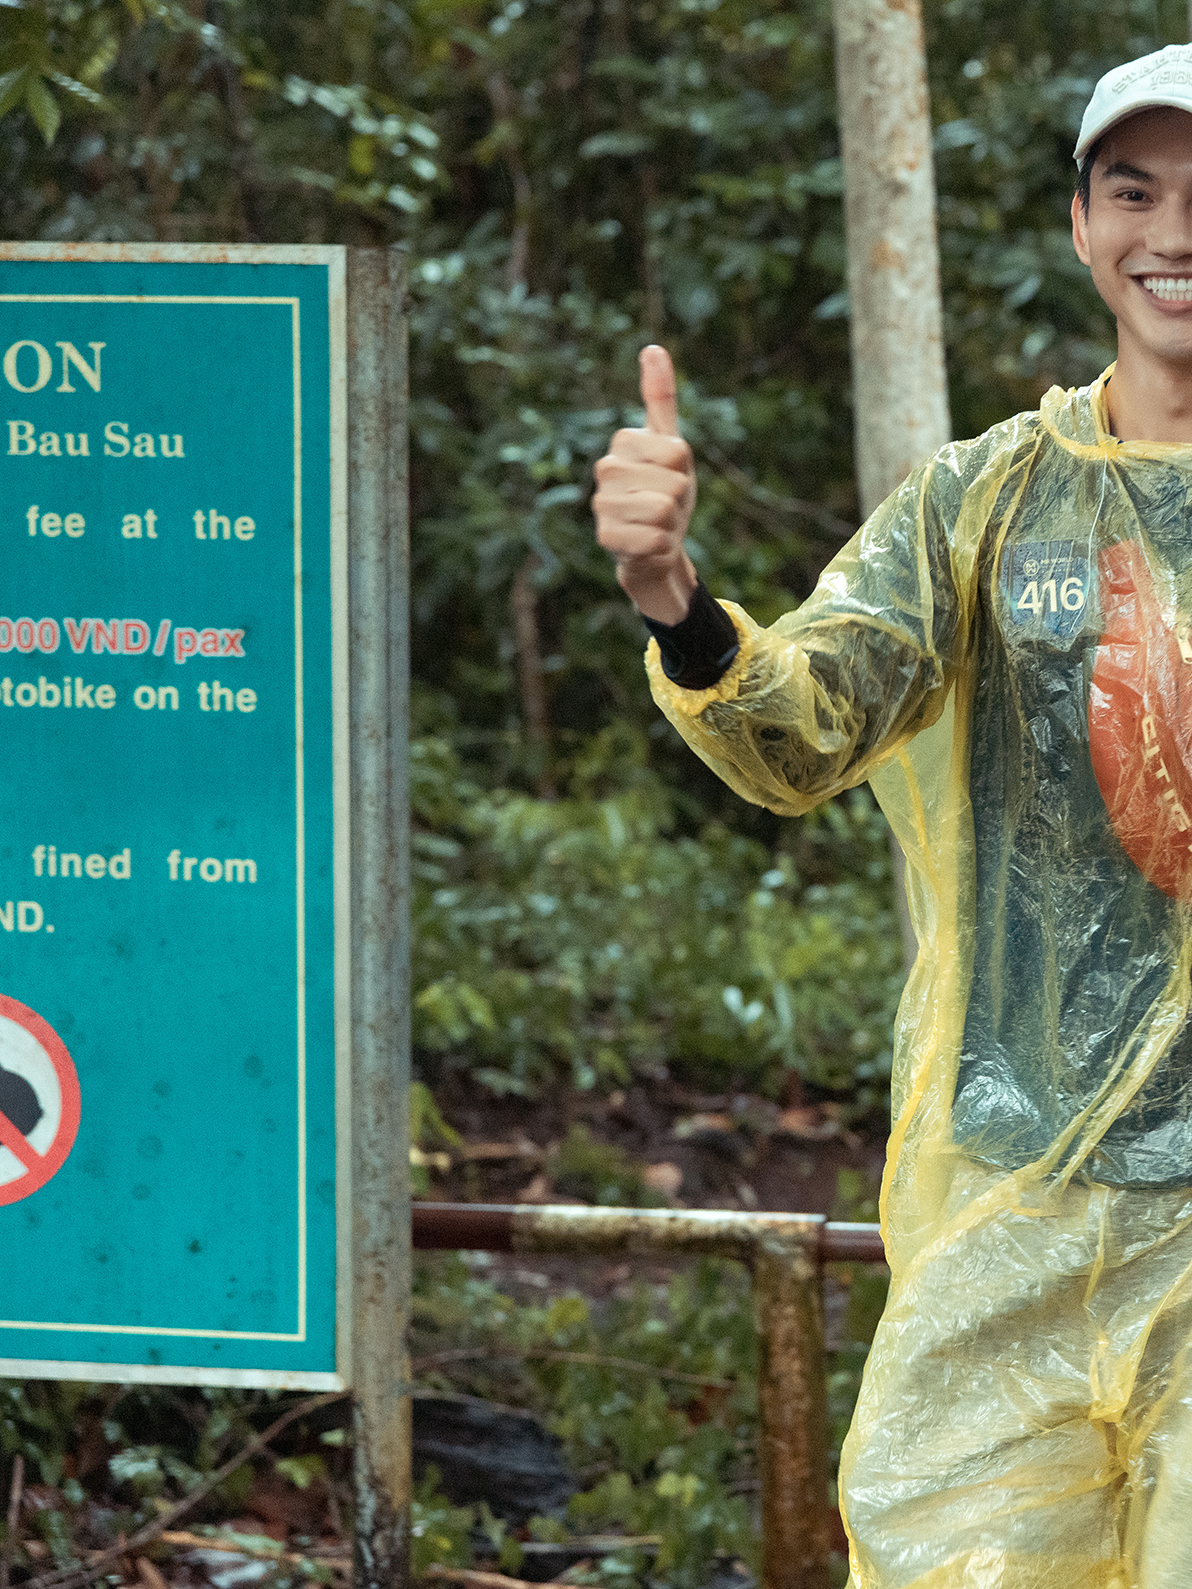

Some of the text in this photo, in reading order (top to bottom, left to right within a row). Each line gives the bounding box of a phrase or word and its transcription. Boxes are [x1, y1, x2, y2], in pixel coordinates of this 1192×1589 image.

[3, 340, 106, 393] ON
[7, 420, 185, 458] Bau Sau
[26, 504, 256, 541] fee at the
[1017, 577, 1085, 615] 416
[133, 685, 179, 711] on
[197, 680, 258, 713] the
[32, 844, 258, 884] fined from
